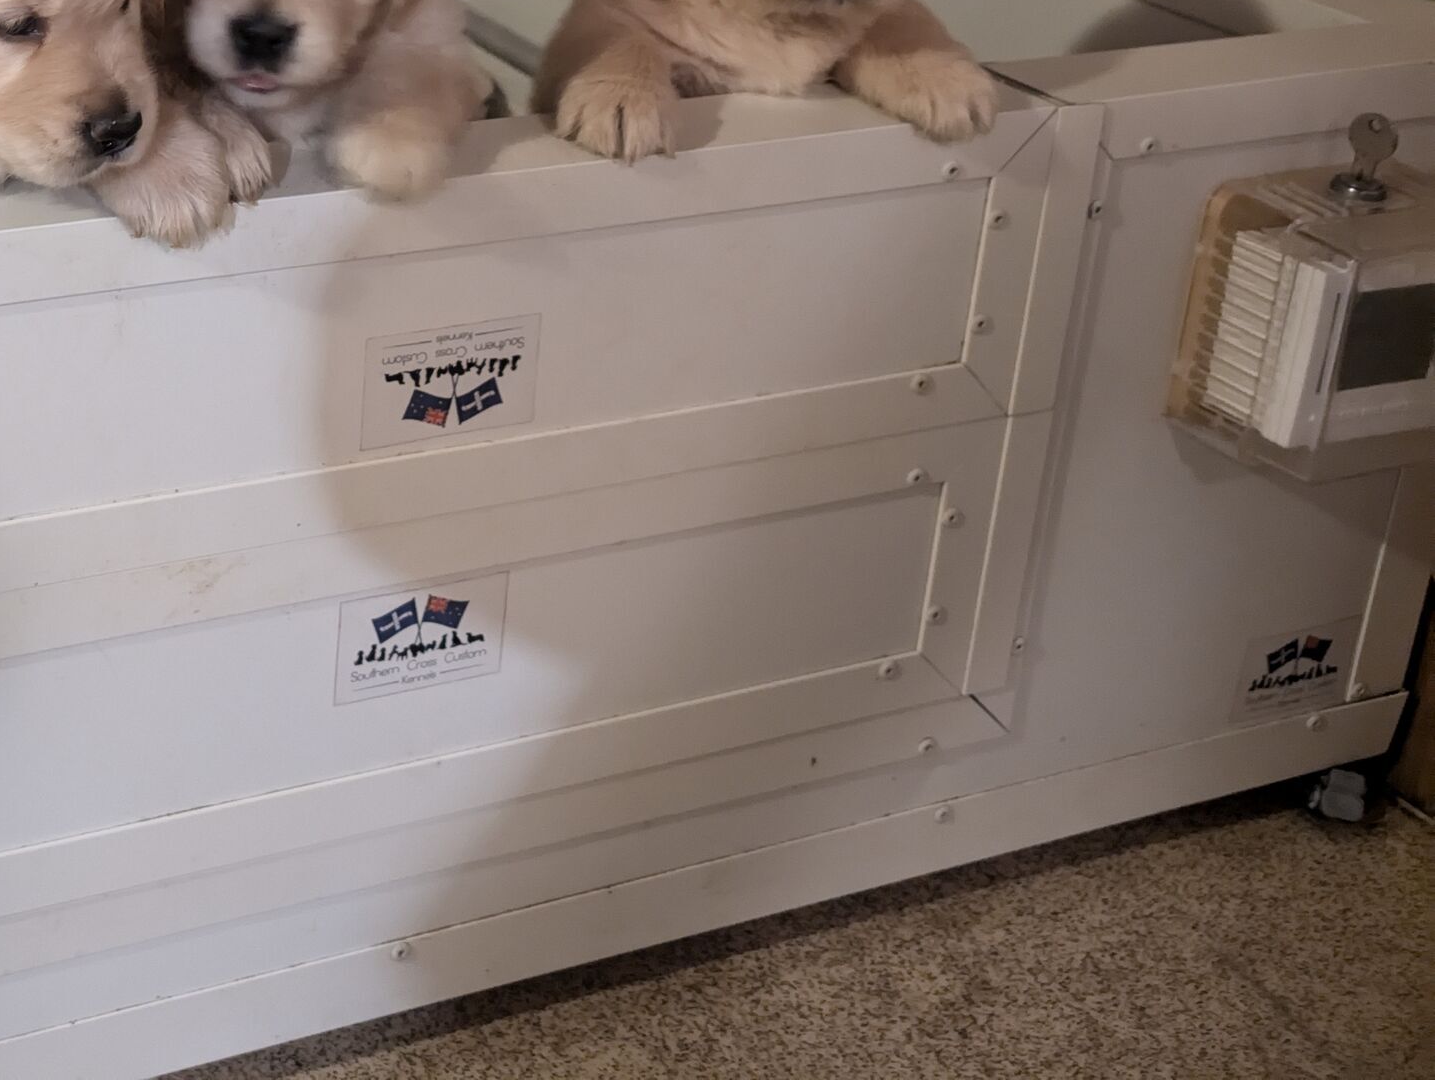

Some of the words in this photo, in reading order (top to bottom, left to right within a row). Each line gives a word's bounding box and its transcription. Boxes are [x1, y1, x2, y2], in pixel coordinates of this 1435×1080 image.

[436, 331, 474, 345] Kennels
[474, 336, 526, 353] Southern
[382, 351, 427, 366] Custom
[435, 345, 468, 358] Cross
[350, 665, 400, 683] Southern
[407, 659, 437, 672] Cross
[444, 648, 487, 664] Custom
[401, 671, 437, 685] Kennels
